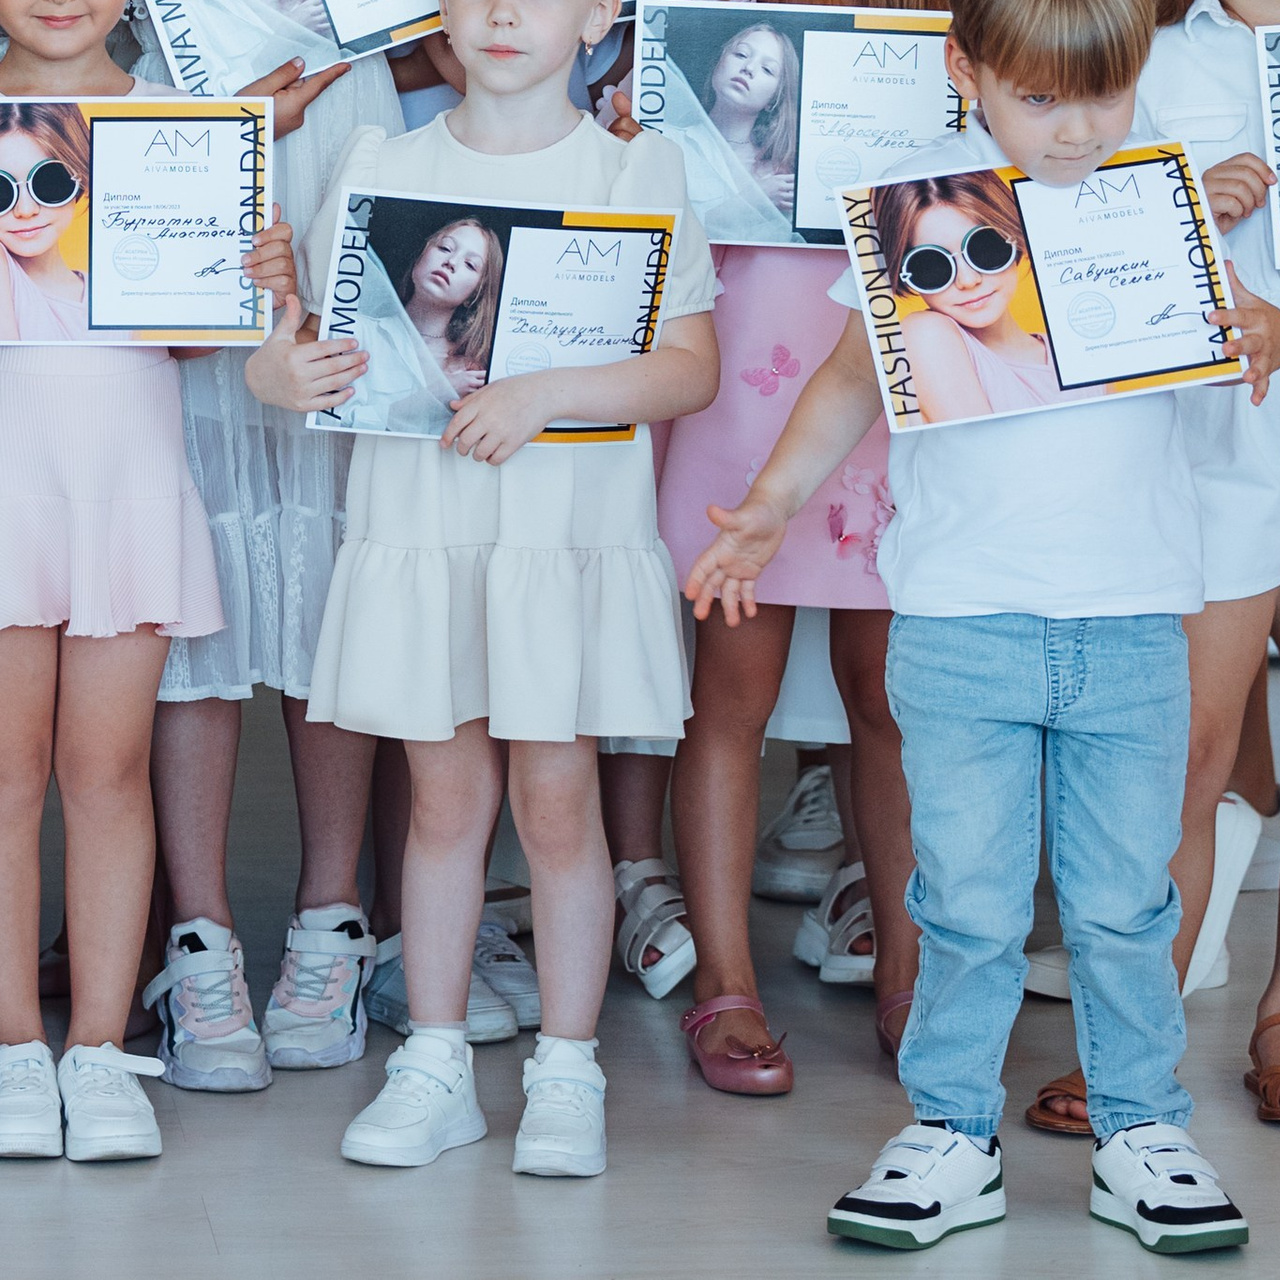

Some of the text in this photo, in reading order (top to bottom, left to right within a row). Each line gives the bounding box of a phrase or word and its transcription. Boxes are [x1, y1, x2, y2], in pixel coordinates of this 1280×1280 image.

[170, 28, 214, 97] AIVA
[853, 41, 918, 70] AM
[852, 76, 916, 86] AIVAMODELS
[811, 100, 849, 110] Диплом
[145, 129, 210, 157] AM
[239, 106, 265, 173] DAY
[145, 165, 209, 173] AIVAMODELS
[1157, 148, 1200, 210] DAY
[103, 193, 141, 202] Диплом
[1074, 173, 1141, 209] AM
[1078, 207, 1144, 224] AIVAMODELS
[329, 197, 375, 335] MODELS
[557, 238, 622, 266] AM
[642, 231, 673, 294] KIDS
[1044, 246, 1082, 260] Диплом
[554, 273, 616, 283] AIVAMODELS
[510, 297, 548, 307] Диплом
[843, 196, 920, 416] FASHION DAY
